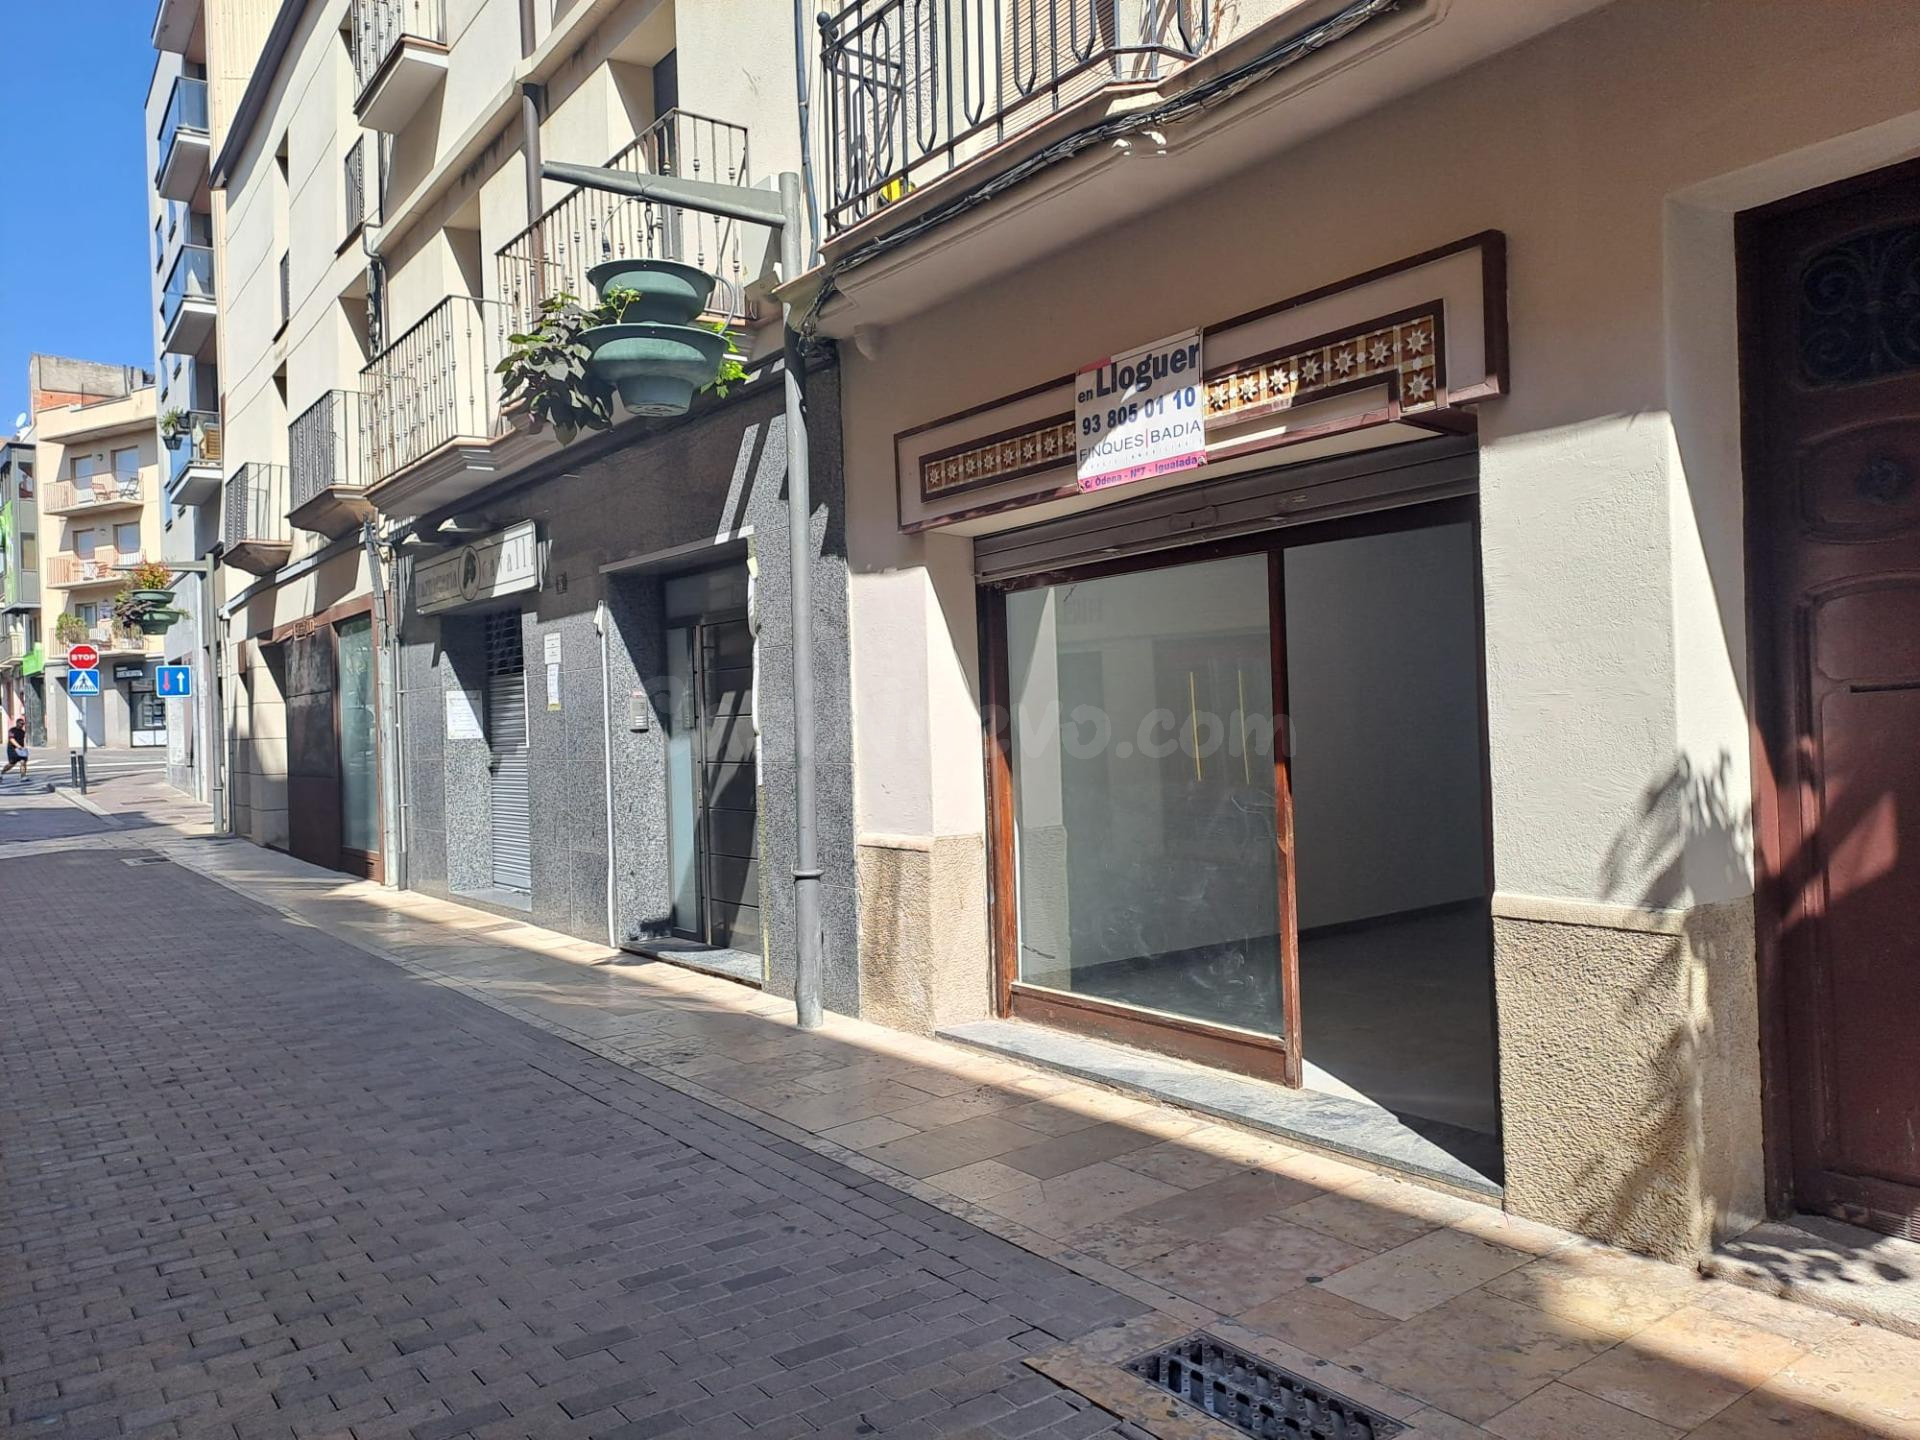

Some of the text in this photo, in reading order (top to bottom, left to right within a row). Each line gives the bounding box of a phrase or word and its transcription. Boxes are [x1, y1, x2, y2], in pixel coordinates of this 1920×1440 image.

[1078, 343, 1200, 403] en Lloguer
[1082, 386, 1196, 436] 93 805 01 10
[1079, 432, 1145, 462] FINQUES
[1151, 419, 1201, 444] BADIA
[1155, 456, 1198, 474] Igualada
